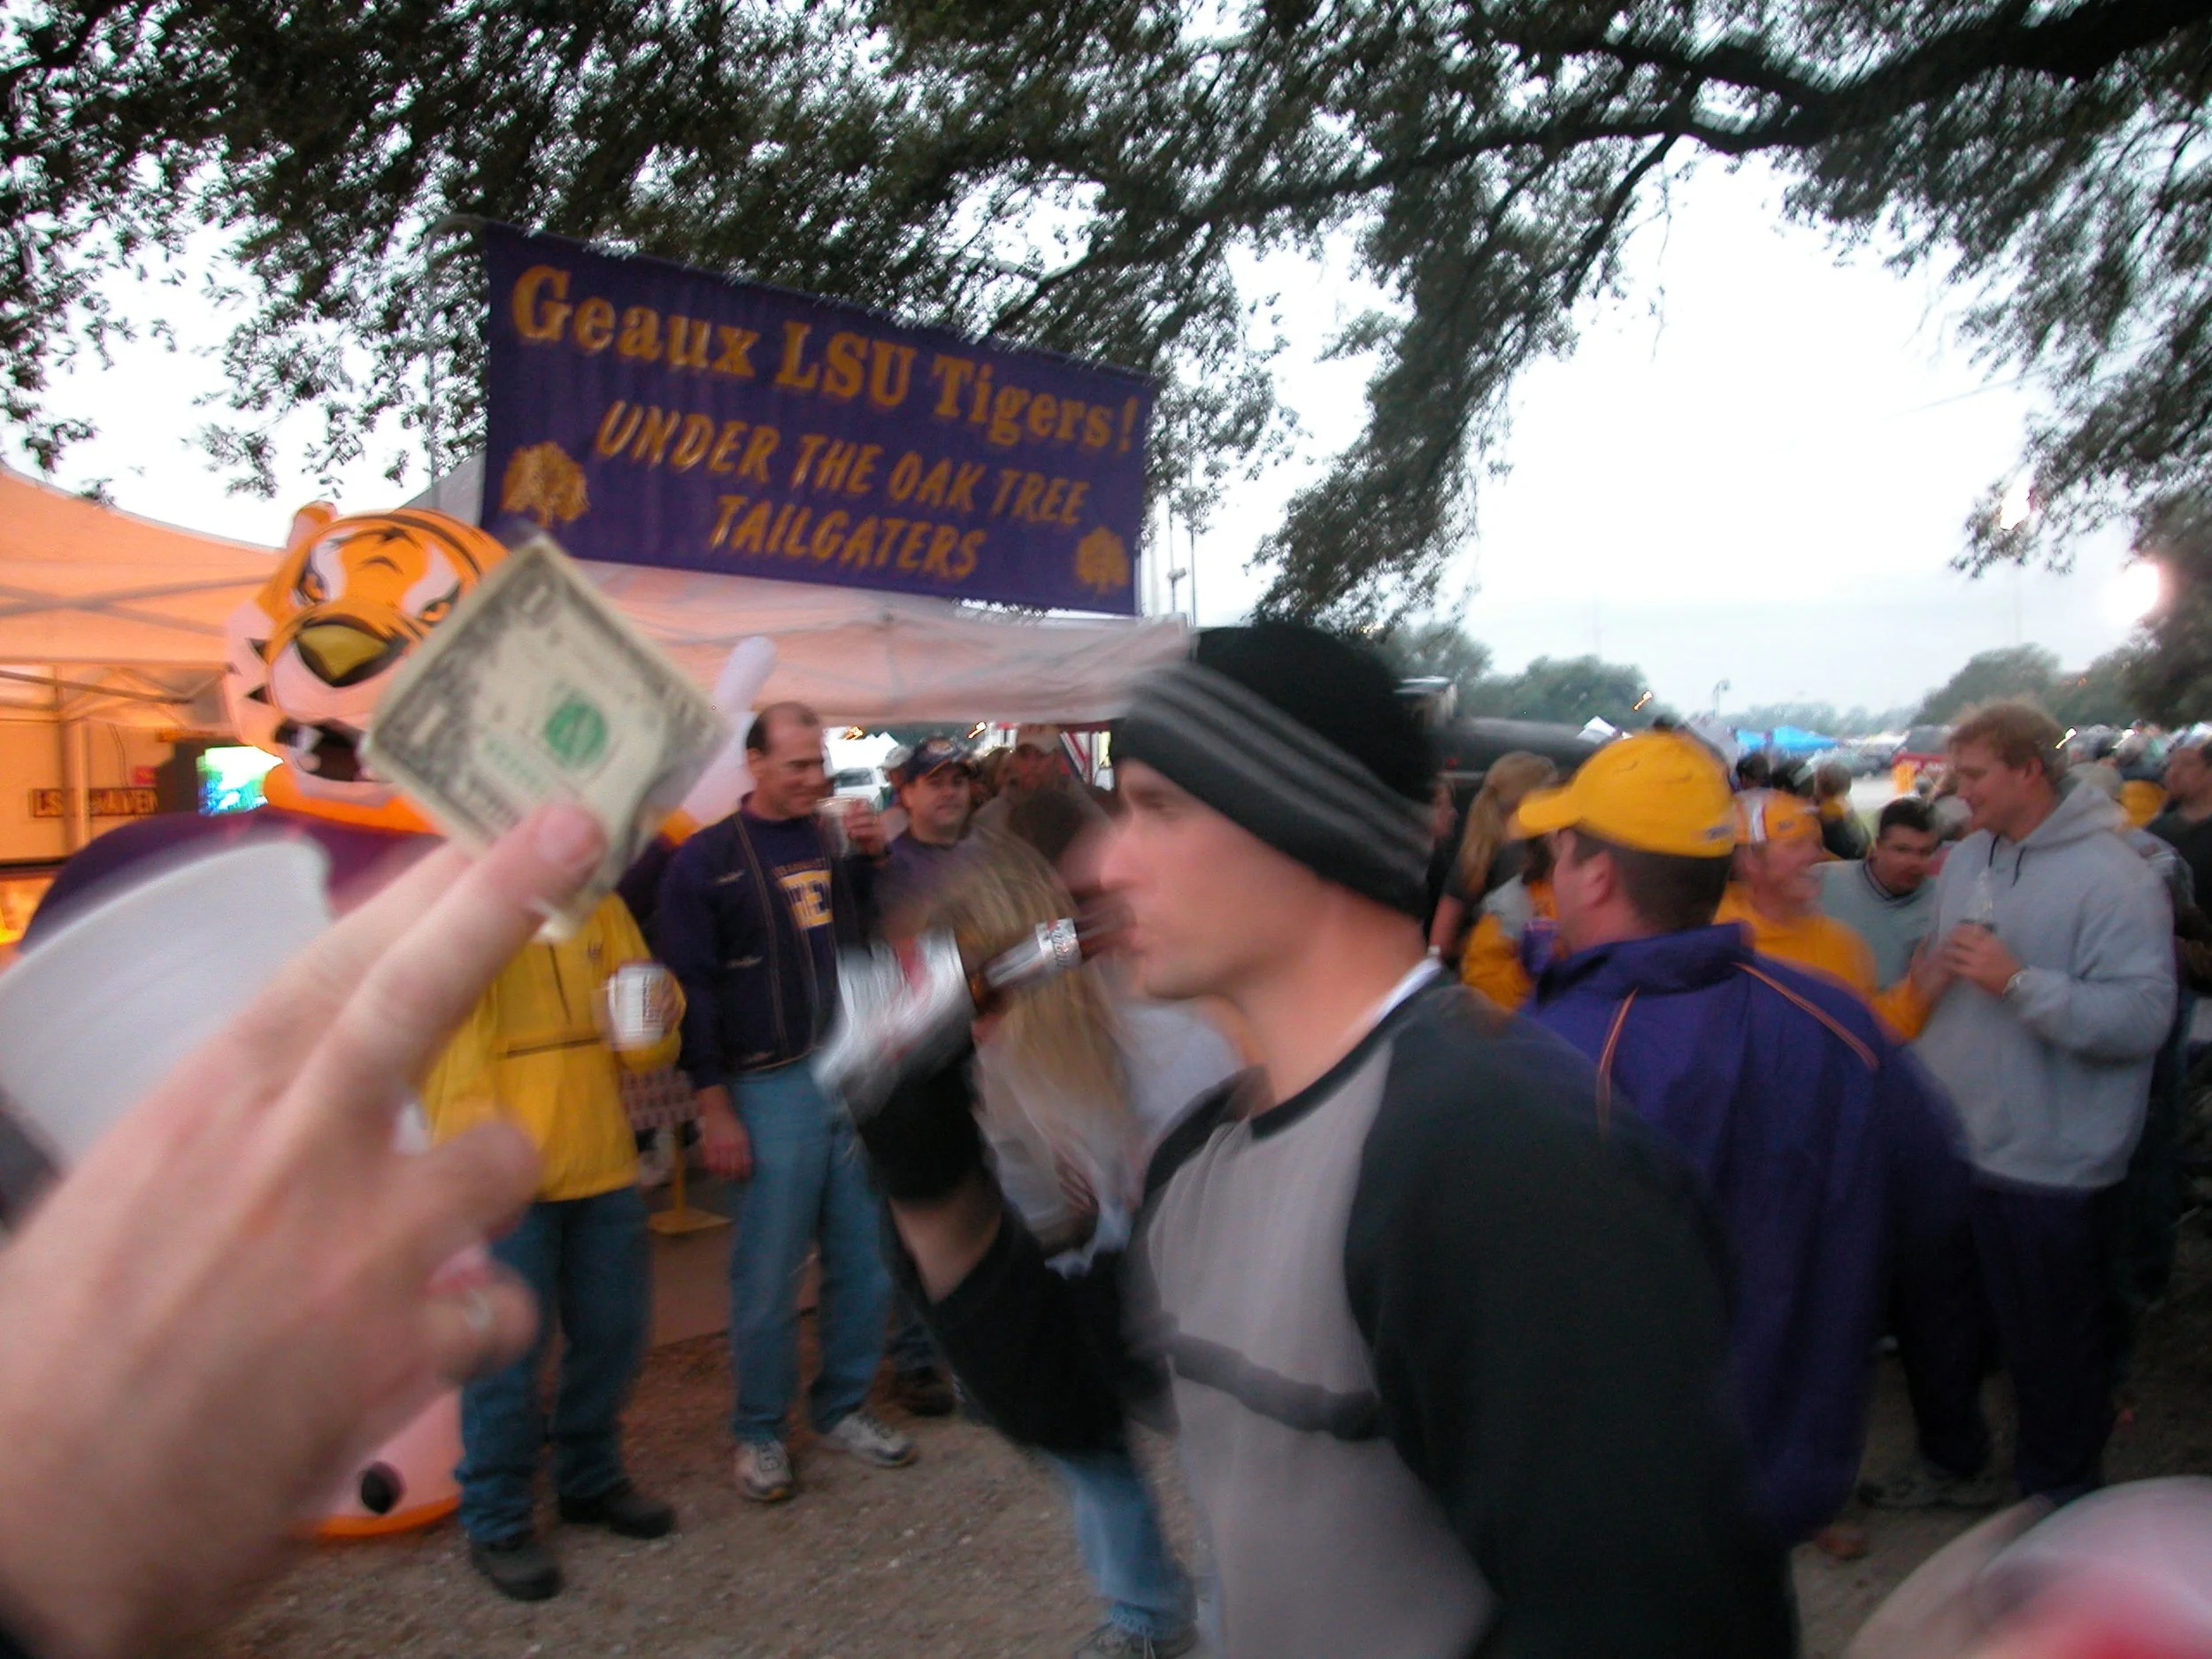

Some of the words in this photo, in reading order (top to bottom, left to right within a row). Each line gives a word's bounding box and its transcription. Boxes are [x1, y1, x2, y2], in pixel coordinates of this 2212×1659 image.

[511, 265, 761, 379] Geaux
[775, 319, 917, 408] LSU
[931, 355, 1139, 452] Tigers!
[596, 399, 780, 483] UNDER
[792, 434, 884, 495] THE
[887, 450, 987, 512] OAK
[991, 467, 1090, 525] TREE
[710, 495, 987, 582] TAILGATERS
